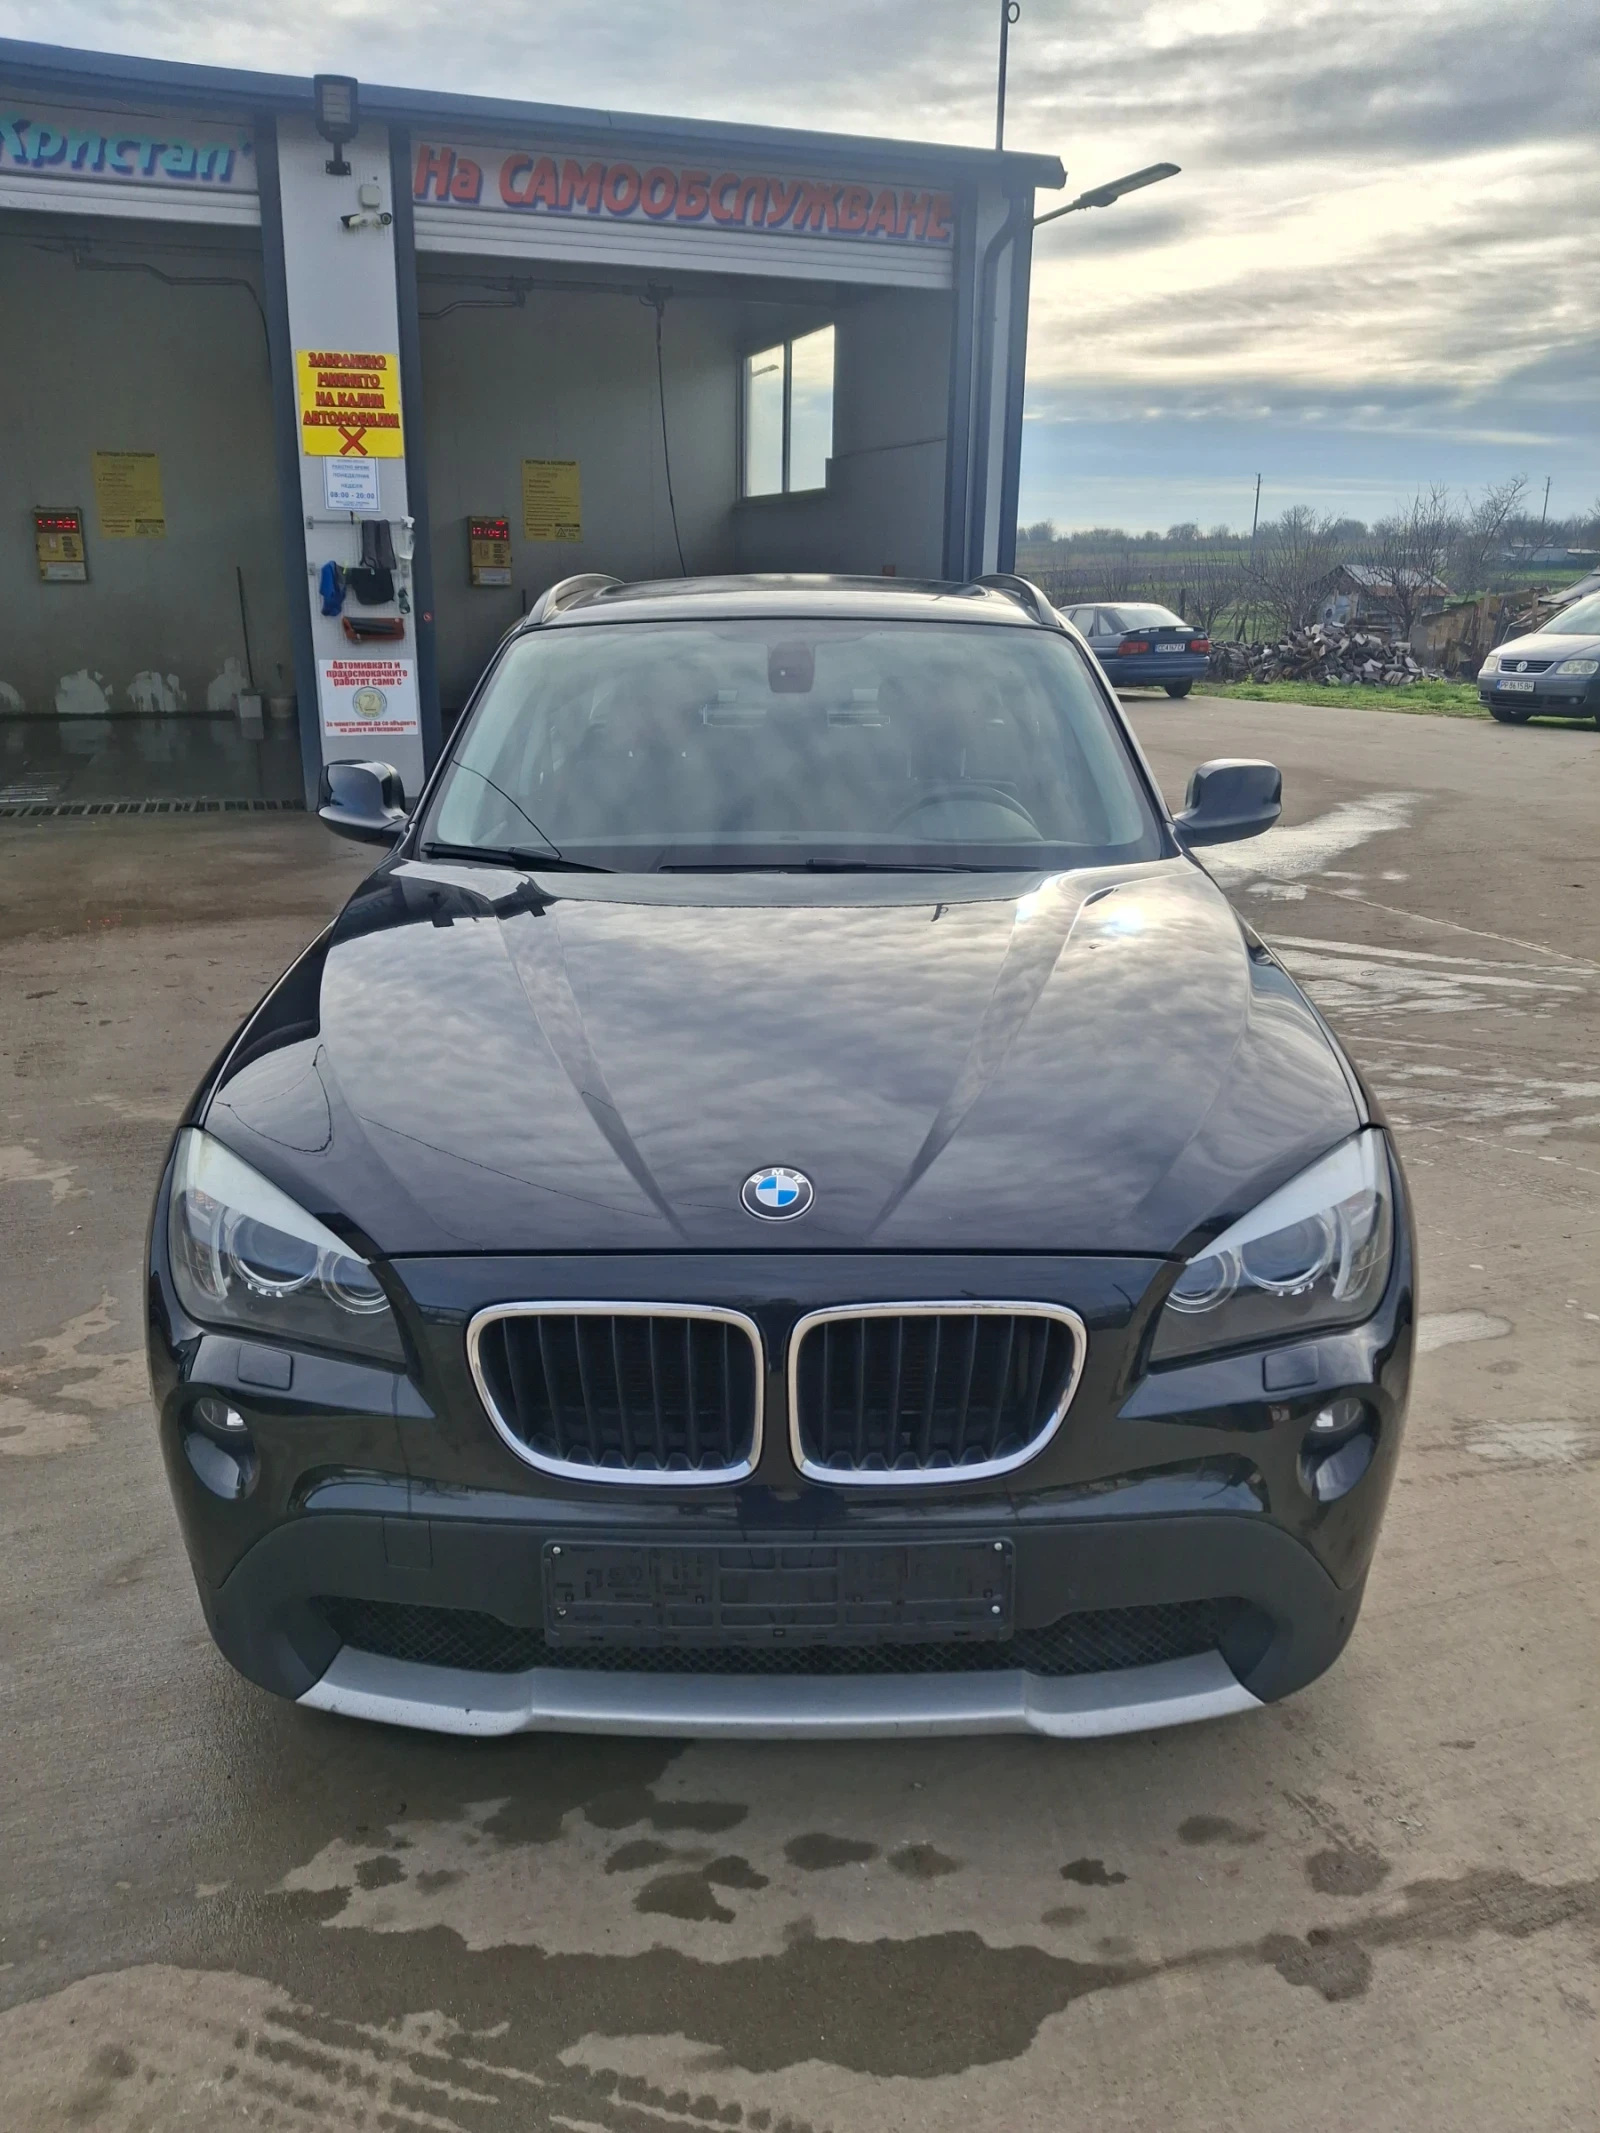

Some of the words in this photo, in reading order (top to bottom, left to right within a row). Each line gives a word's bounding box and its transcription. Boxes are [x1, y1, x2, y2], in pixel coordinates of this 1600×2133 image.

[413, 143, 483, 204] На
[499, 153, 953, 242] САМООБСЛУЖВАНЕ
[308, 352, 387, 370] ЗАБРАНЕНО
[317, 372, 382, 389] МИЕНЕТО
[315, 391, 335, 407] НА
[337, 392, 385, 409] КАЛНИ
[303, 410, 400, 428] АВТОМОБИЛИ
[333, 661, 393, 669] Автомивката
[326, 670, 407, 678] прахосмокачките
[333, 677, 370, 686] работят
[751, 1169, 806, 1183] BMW
